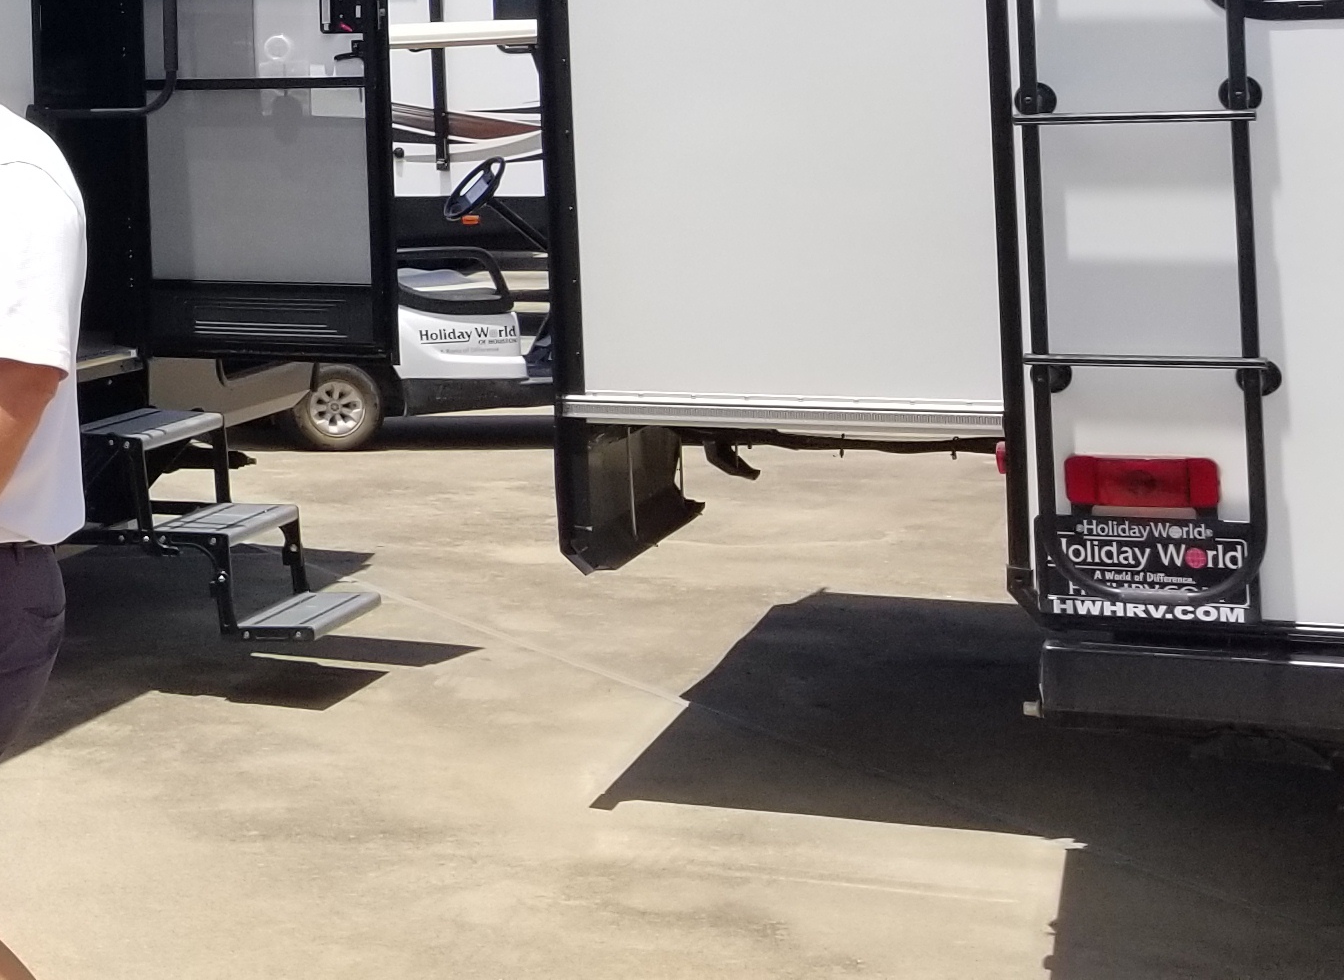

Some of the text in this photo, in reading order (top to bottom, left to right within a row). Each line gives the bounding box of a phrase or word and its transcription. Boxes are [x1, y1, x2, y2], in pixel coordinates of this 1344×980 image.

[419, 325, 517, 343] Holiday World
[1156, 542, 1243, 570] World
[1094, 570, 1102, 580] A
[1105, 571, 1131, 581] World
[1134, 572, 1144, 582] of
[1053, 598, 1246, 623] HWHRV.COM
